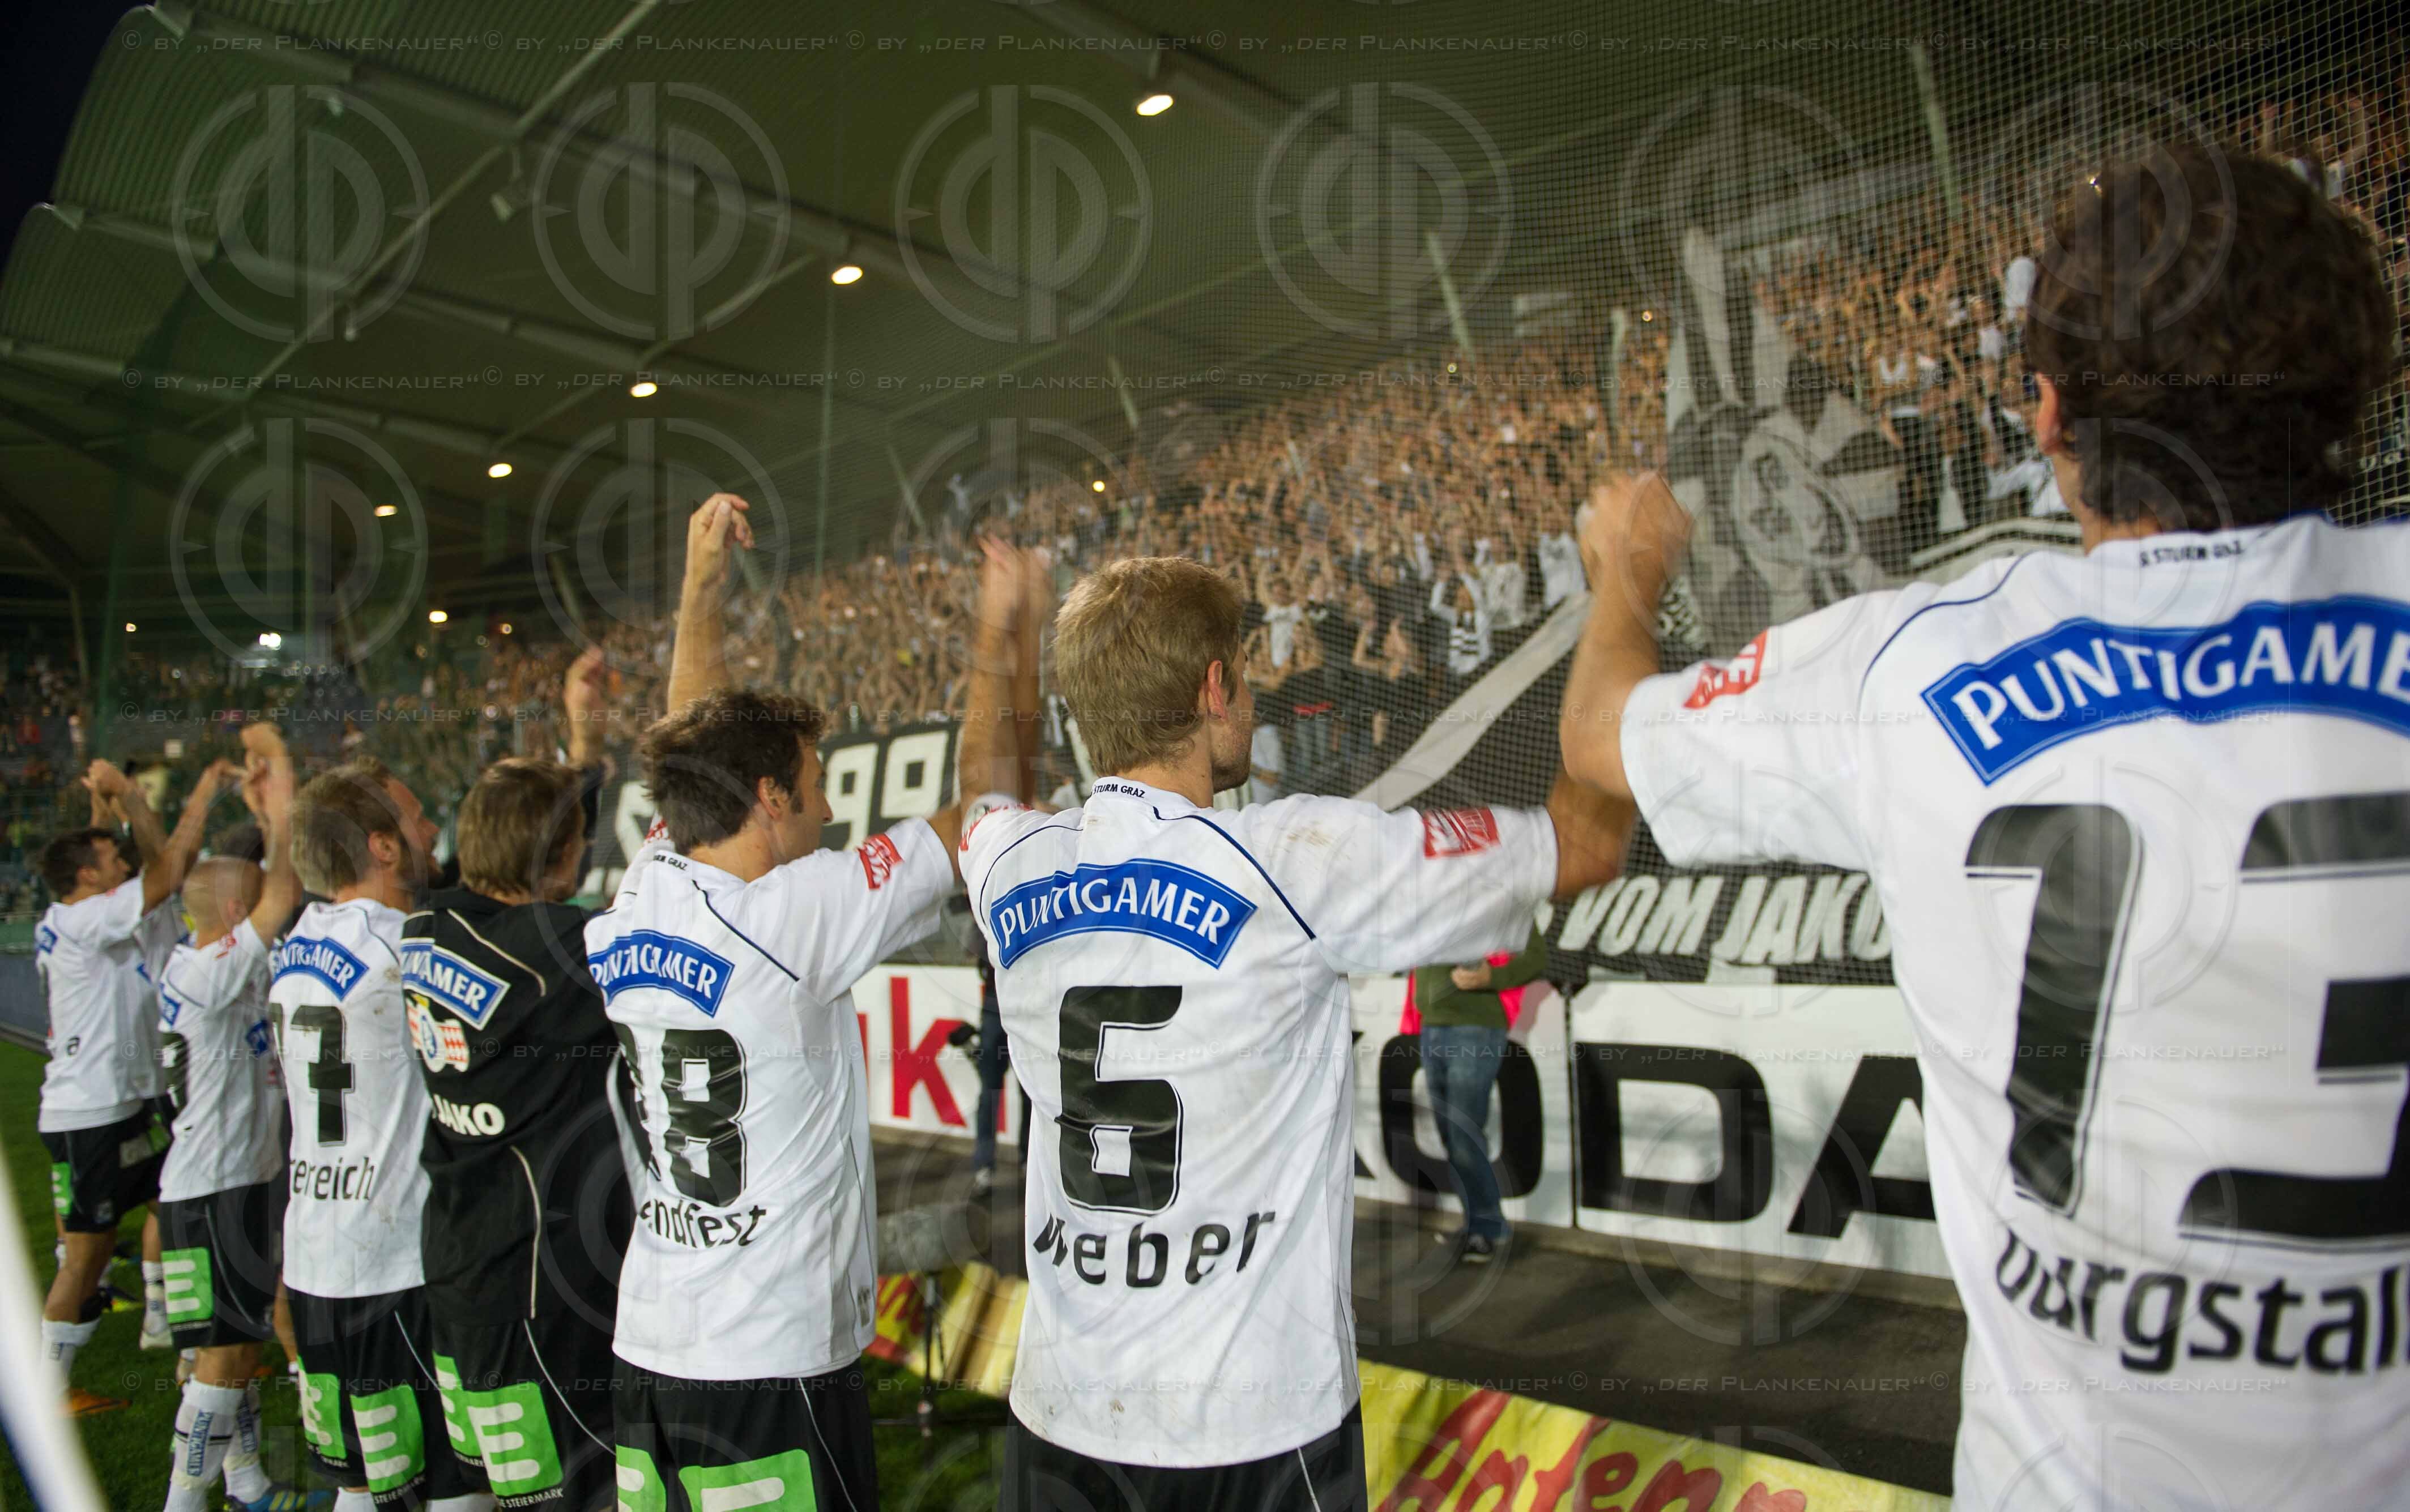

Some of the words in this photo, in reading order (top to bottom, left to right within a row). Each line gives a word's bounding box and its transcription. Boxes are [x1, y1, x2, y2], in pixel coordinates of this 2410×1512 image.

[1951, 621, 2410, 750] PUNTIGAME
[1120, 785, 1145, 798] GRAZ
[999, 877, 1231, 946] PUNTIGAMER
[1558, 875, 1724, 956] VOM
[1711, 873, 1893, 965] JAKO
[1964, 790, 2410, 1256] 13
[1055, 985, 1184, 1216] 6
[1354, 1031, 1937, 1239] ODA
[1995, 1227, 2410, 1374] burgstal
